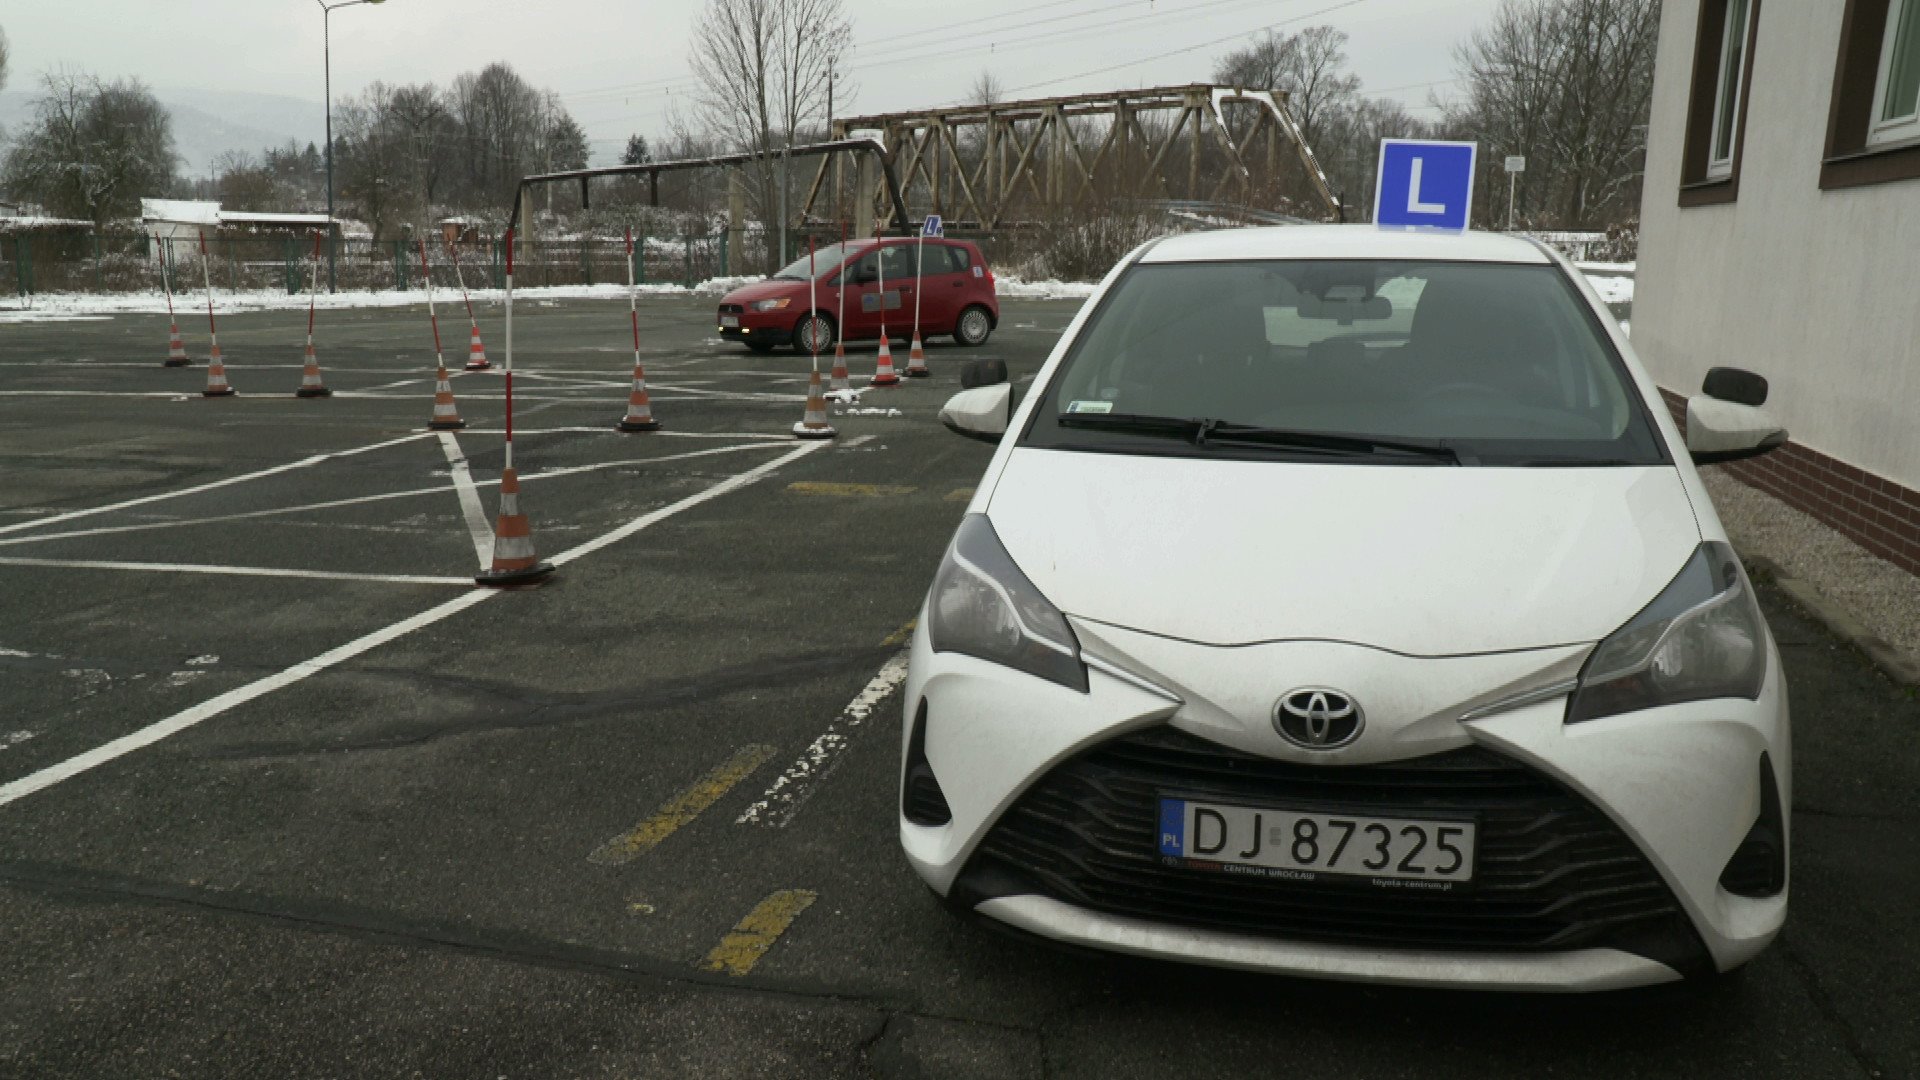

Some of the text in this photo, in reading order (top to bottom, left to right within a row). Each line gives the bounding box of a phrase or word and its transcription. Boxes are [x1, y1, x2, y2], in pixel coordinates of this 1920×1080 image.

[1407, 156, 1446, 215] L
[1162, 834, 1180, 848] PL
[1193, 806, 1463, 875] DJ 87325
[1223, 864, 1266, 876] CENTRUM
